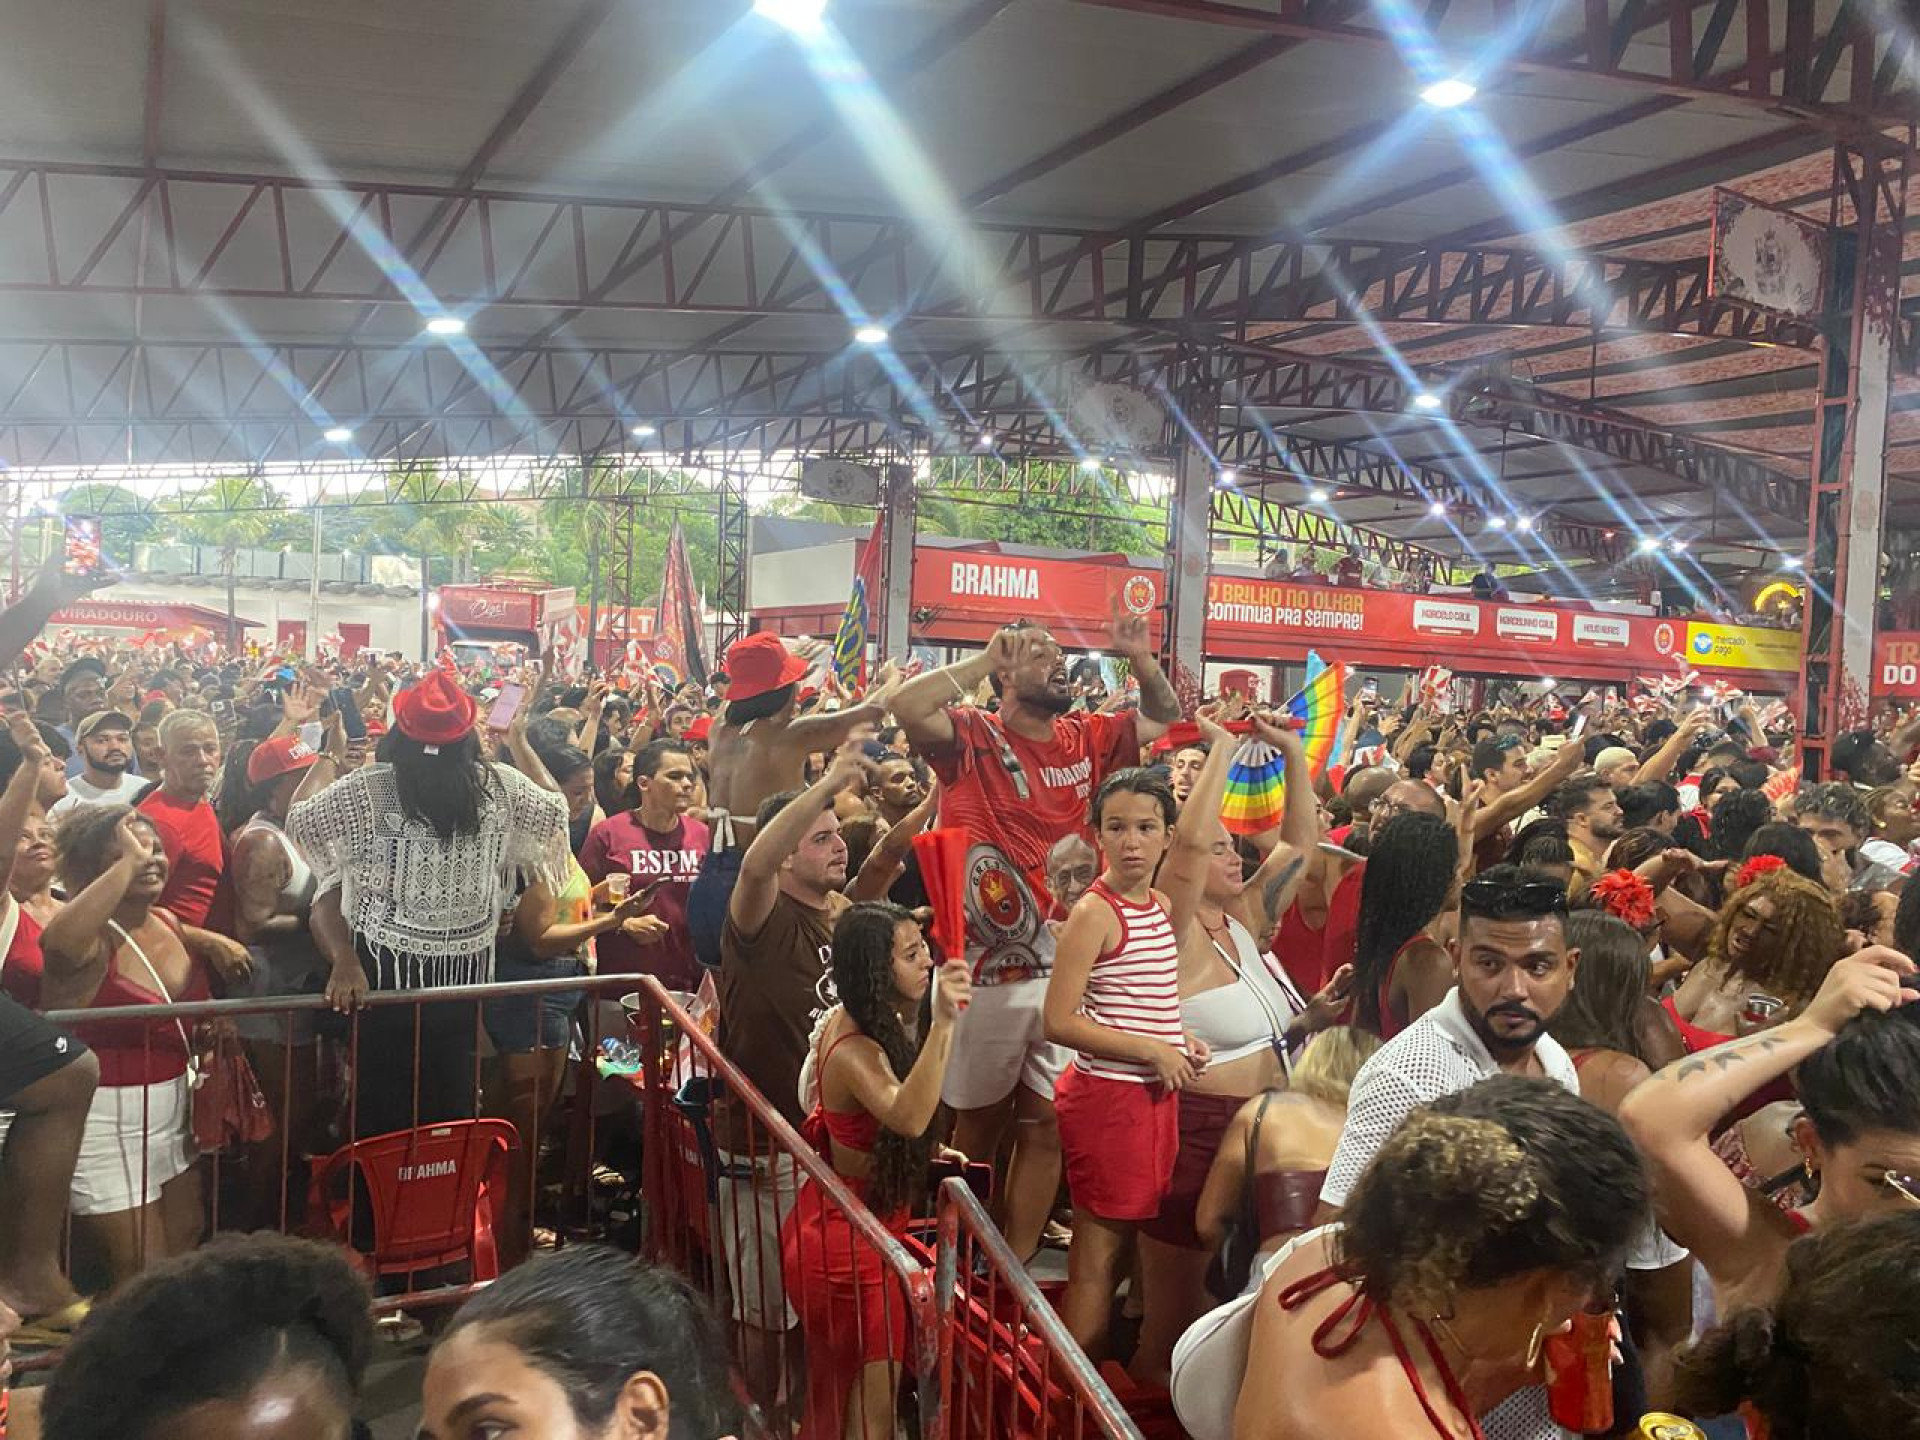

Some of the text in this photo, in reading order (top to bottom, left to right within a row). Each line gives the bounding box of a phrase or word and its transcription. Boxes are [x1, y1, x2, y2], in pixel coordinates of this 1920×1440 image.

[951, 562, 1039, 600] BRAHMA
[1223, 584, 1282, 607] BRILHO
[59, 607, 157, 623] VIRADOURO
[1883, 665, 1916, 685] DO
[631, 849, 700, 874] ESPM
